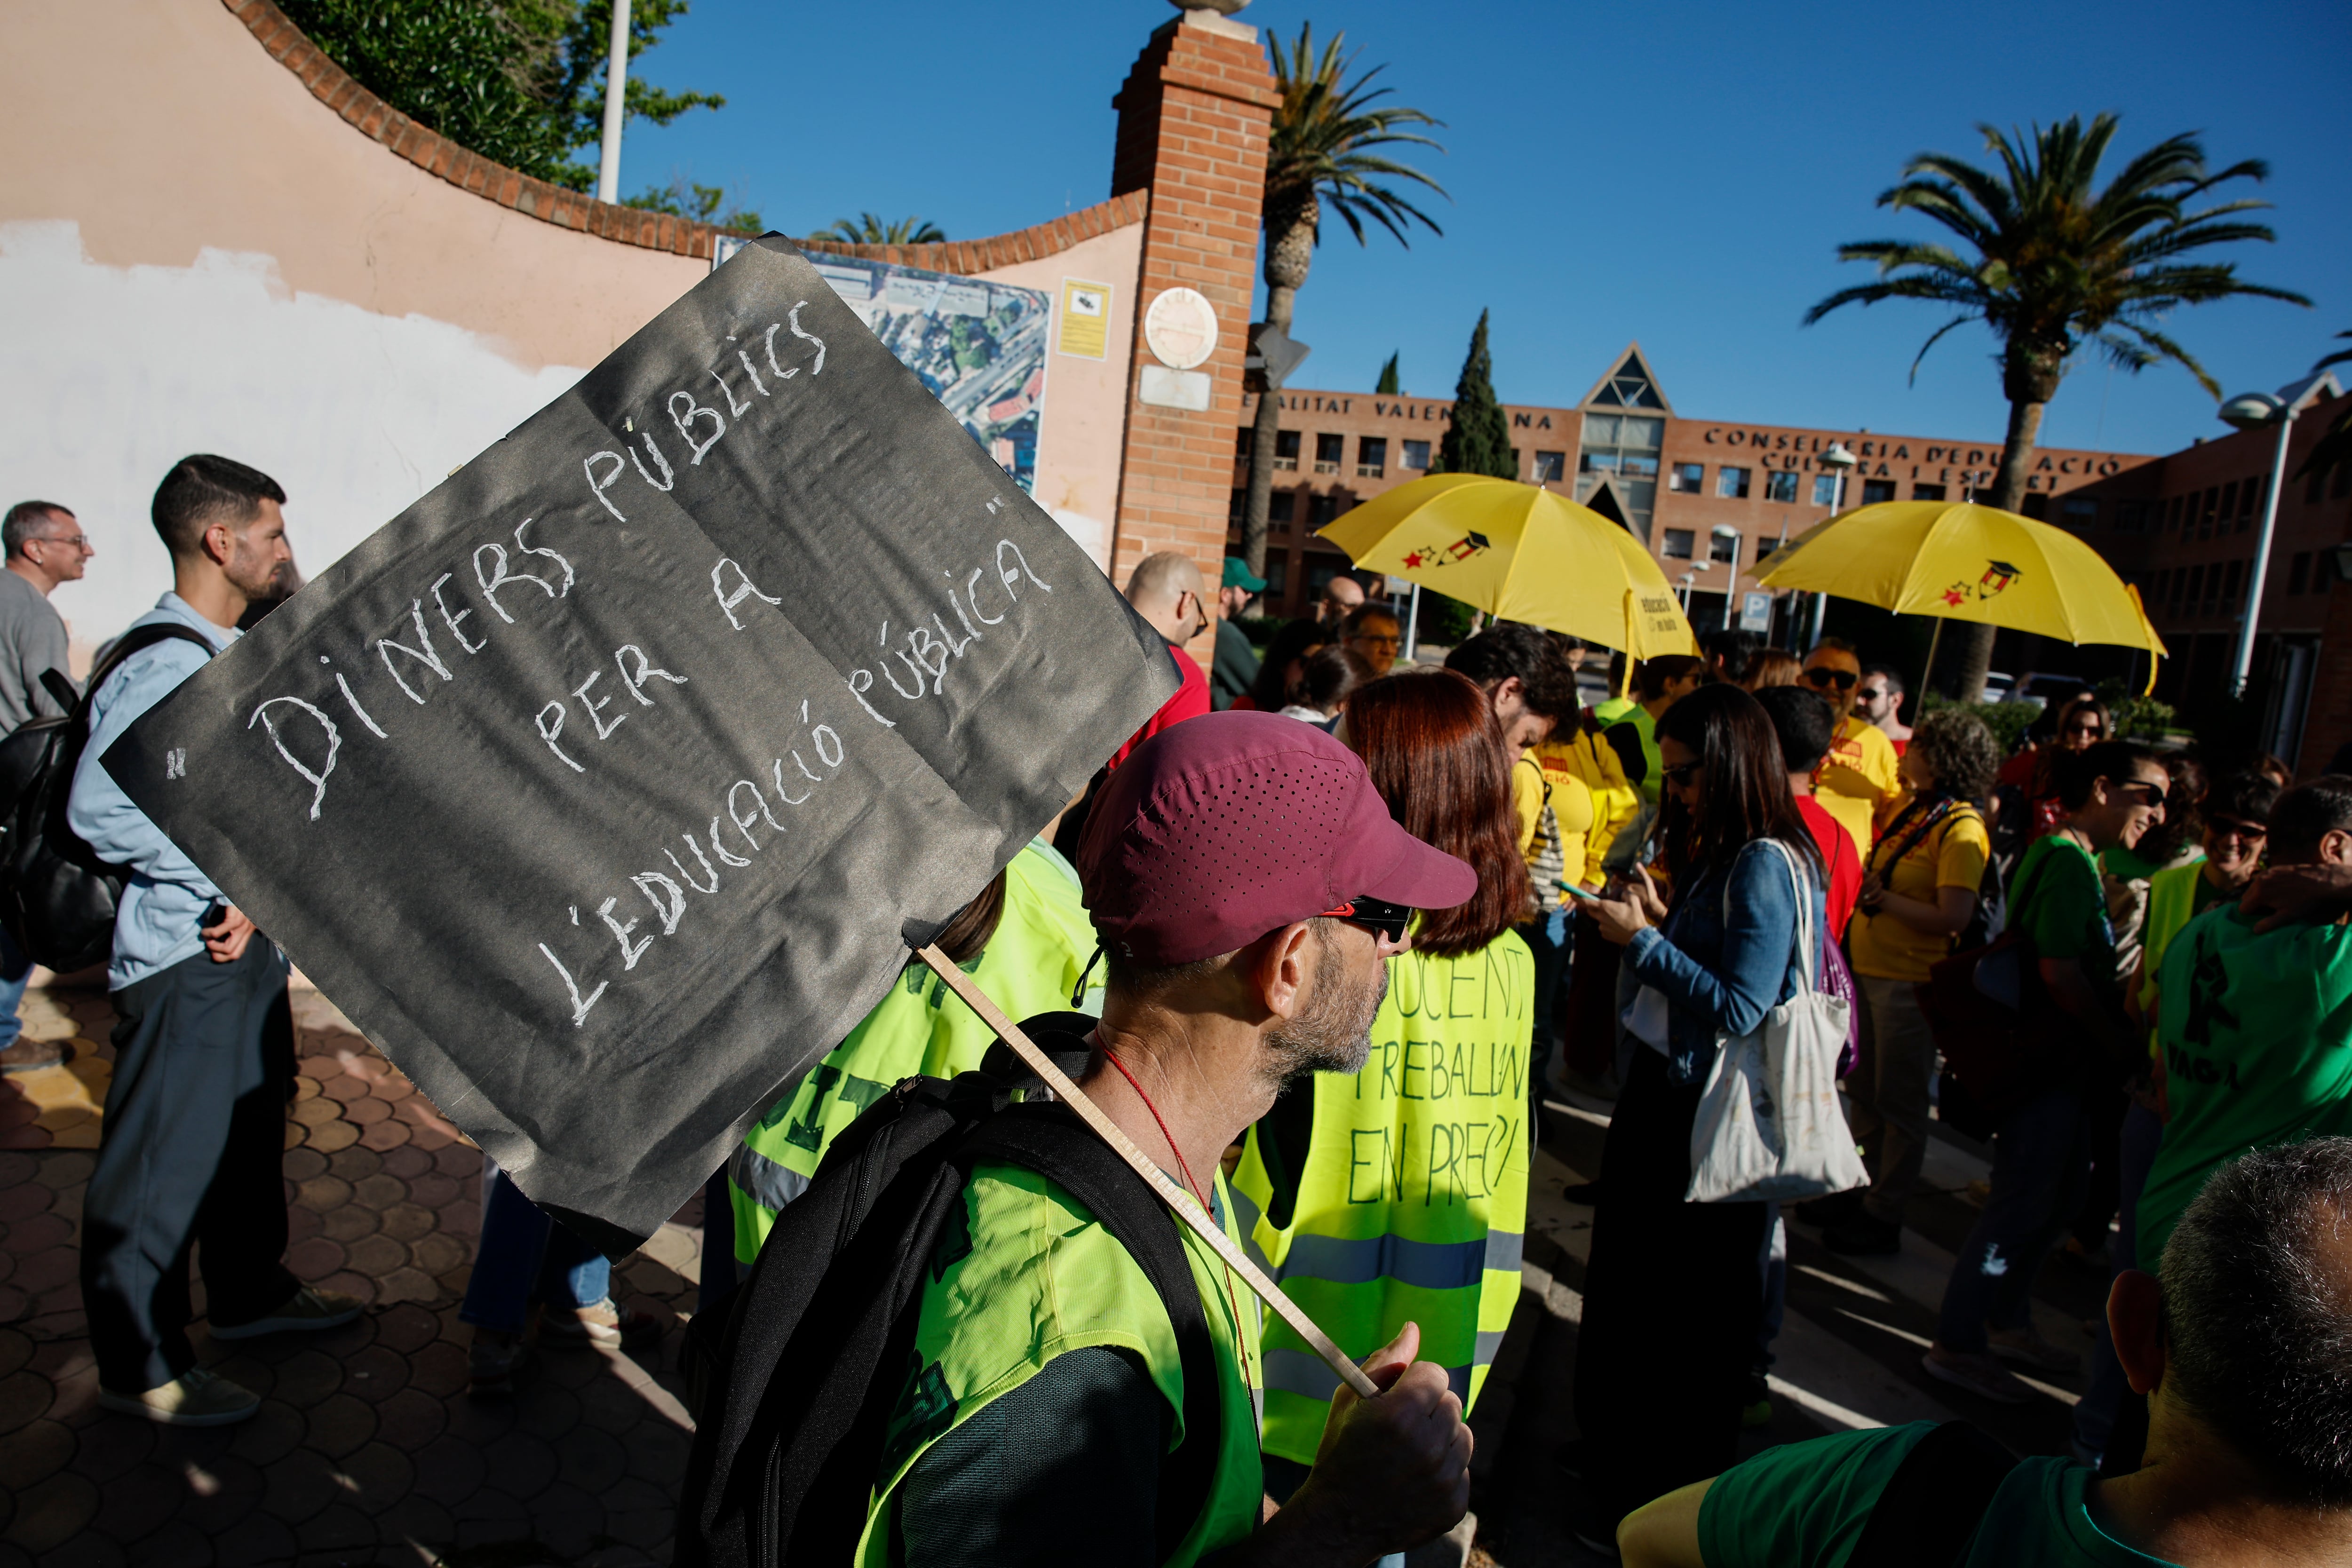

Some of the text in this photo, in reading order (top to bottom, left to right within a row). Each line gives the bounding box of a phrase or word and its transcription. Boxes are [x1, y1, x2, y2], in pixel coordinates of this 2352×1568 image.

[1375, 401, 1551, 430] VALENNA
[1926, 446, 2121, 476] D'EDUACIÓ
[1940, 467, 2059, 491] ESPRT
[1748, 596, 1766, 617] P
[534, 558, 782, 773] PER A
[537, 699, 844, 1028] L'EDUCACIÓ
[1394, 944, 1523, 1021] OCENT
[1348, 1123, 1406, 1204] EN
